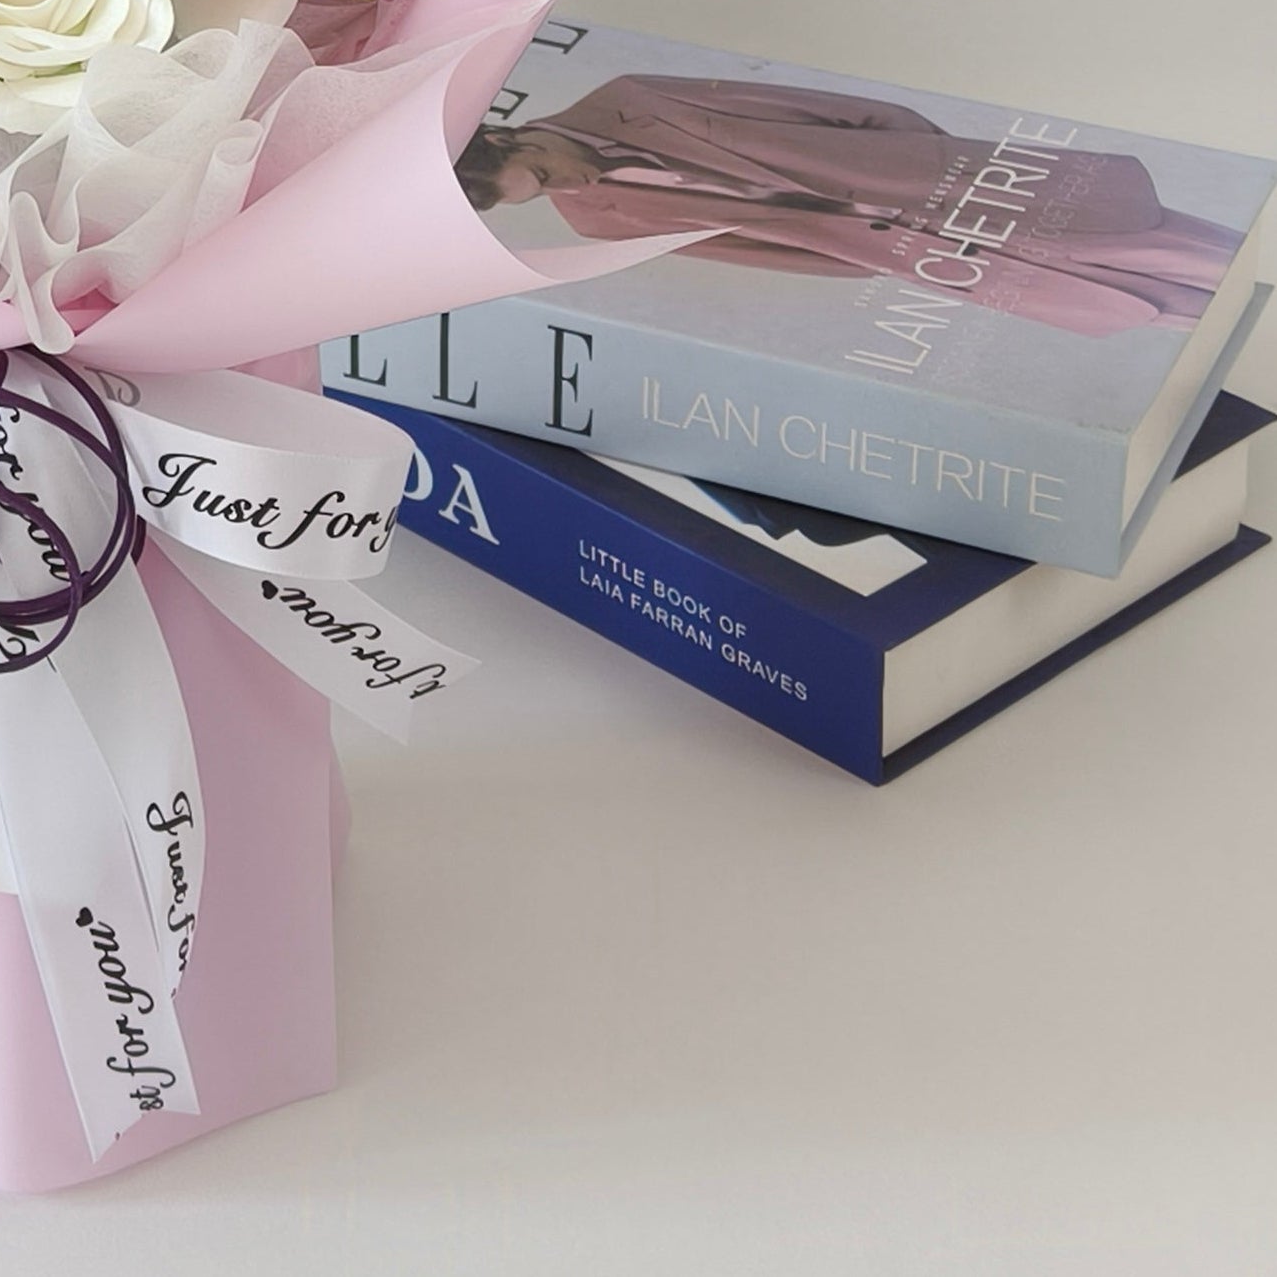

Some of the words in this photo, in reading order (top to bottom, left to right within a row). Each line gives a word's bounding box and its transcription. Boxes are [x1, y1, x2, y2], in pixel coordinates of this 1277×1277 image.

[844, 288, 963, 374] ILAN
[914, 117, 1078, 289] CHETRITE
[642, 376, 760, 448] ILAN
[778, 415, 1066, 522] CHETRITE
[142, 452, 280, 528] Just
[256, 490, 382, 550] for
[279, 586, 381, 644] you
[579, 539, 646, 589] LITTLE
[653, 578, 712, 624] BOOK
[719, 615, 747, 639] OF
[579, 566, 624, 603] LAIA
[630, 593, 713, 651] FARRAN
[721, 642, 808, 702] GRAVES
[351, 646, 446, 689] for
[146, 790, 194, 904] Just
[89, 921, 154, 1014] you
[106, 1013, 176, 1088] for
